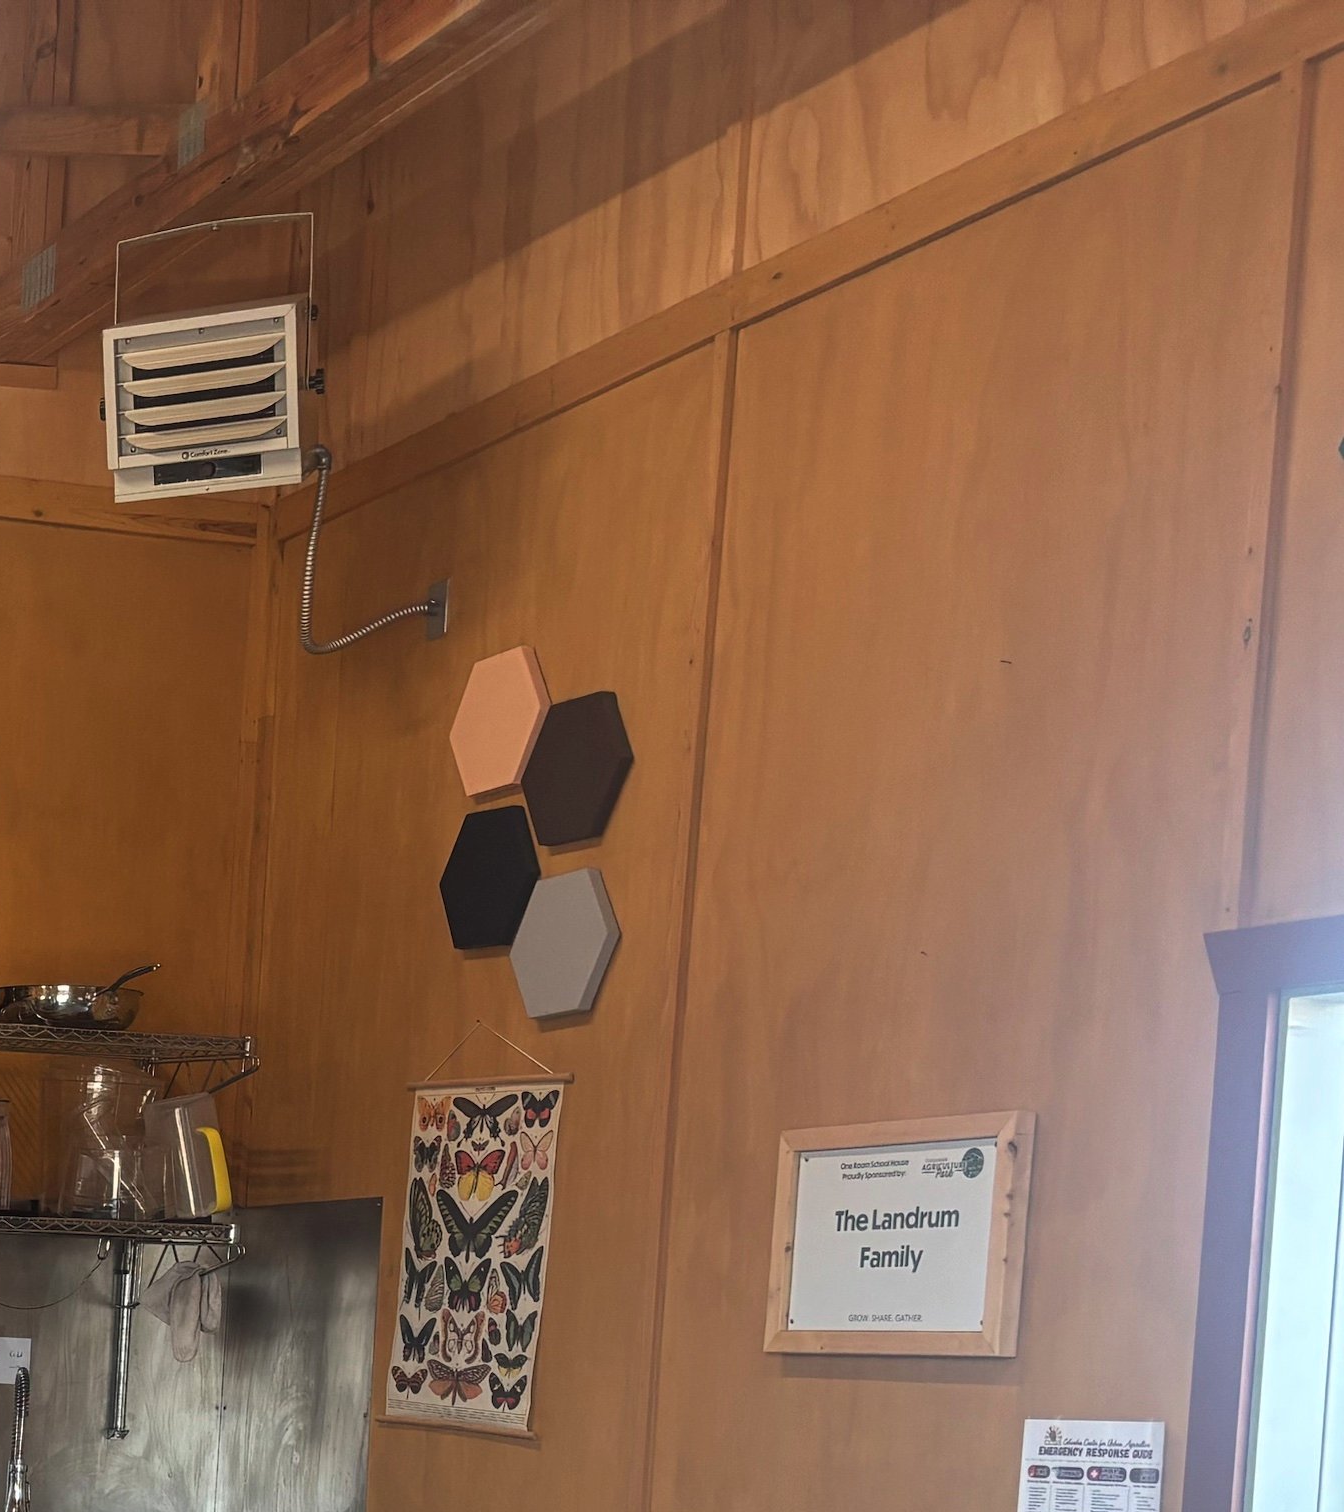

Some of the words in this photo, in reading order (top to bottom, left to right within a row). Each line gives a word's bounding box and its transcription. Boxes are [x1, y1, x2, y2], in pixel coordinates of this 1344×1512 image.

[834, 1210, 869, 1232] The
[871, 1206, 960, 1231] Landrum
[859, 1244, 924, 1273] Family
[1038, 1446, 1083, 1457] EMERGENCY
[1085, 1447, 1130, 1458] RESPONSE
